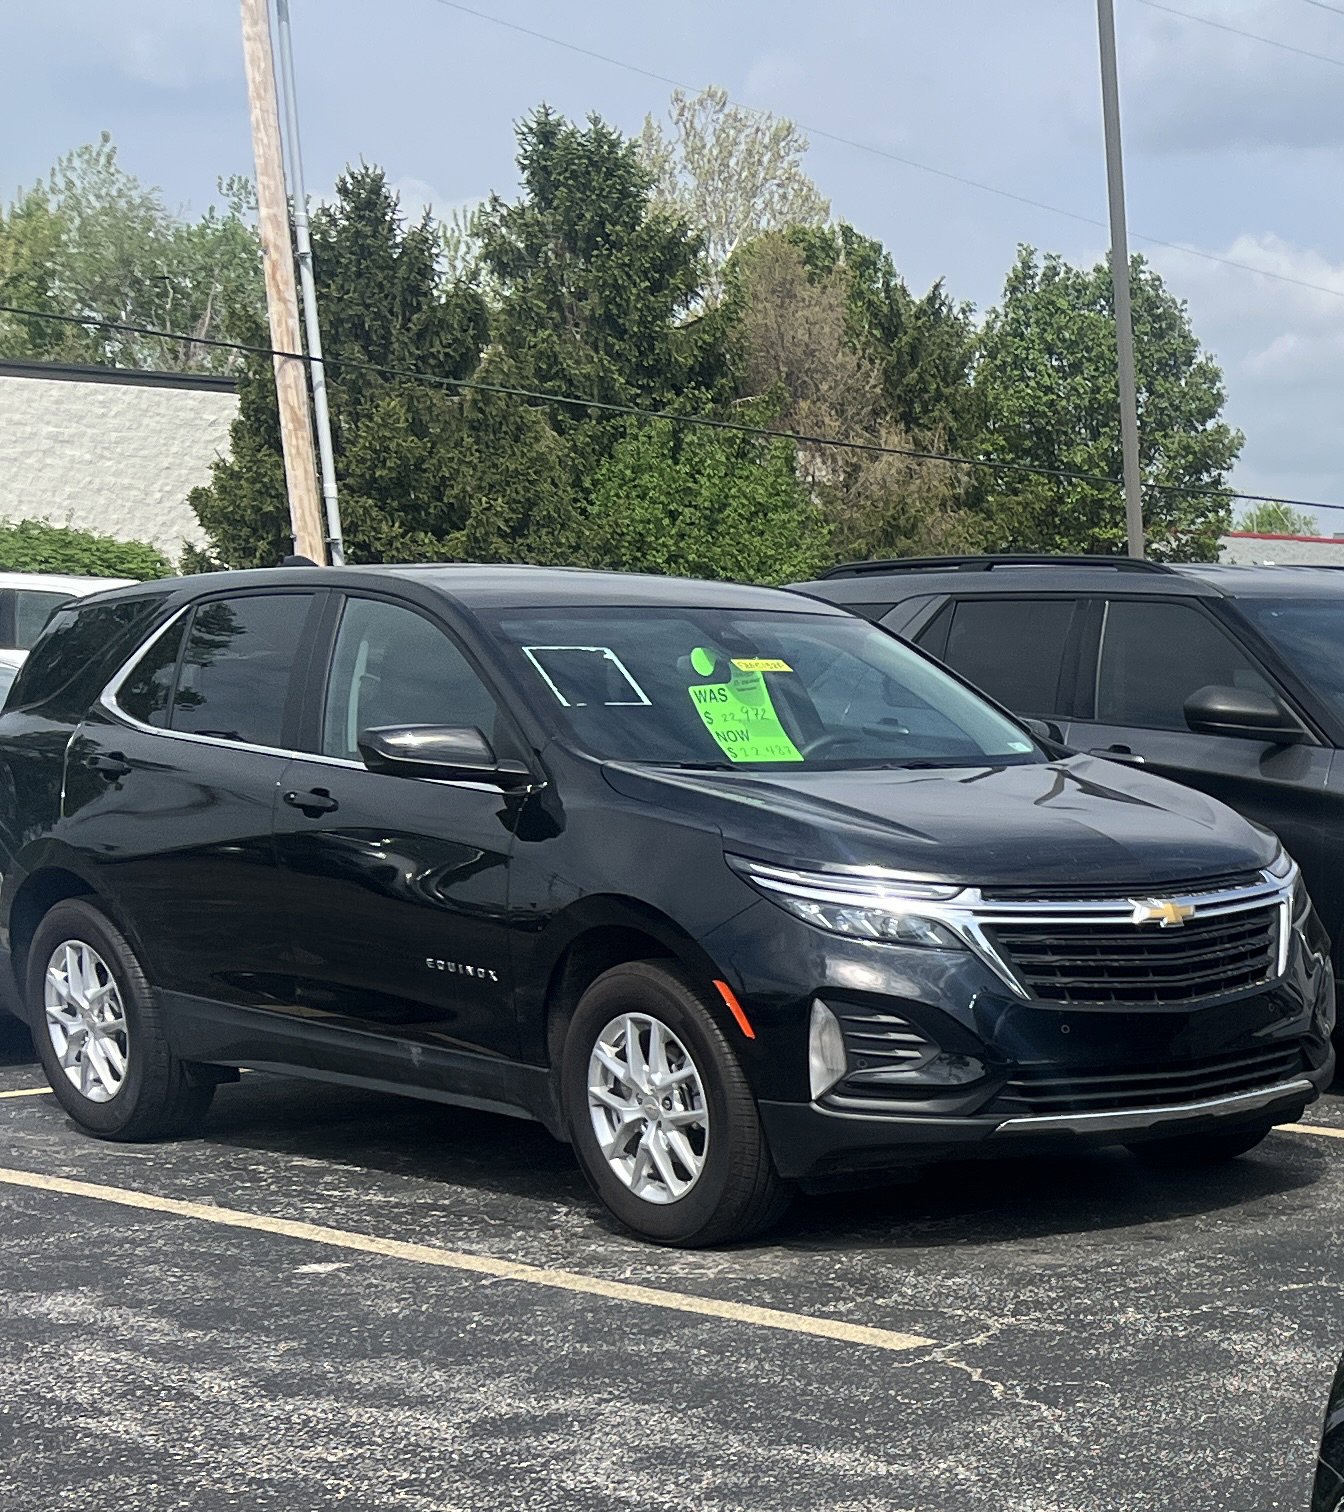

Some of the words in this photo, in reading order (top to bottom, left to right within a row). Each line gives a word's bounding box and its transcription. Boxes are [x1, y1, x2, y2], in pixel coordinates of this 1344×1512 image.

[693, 687, 729, 703] WAS
[715, 729, 750, 743] NOW
[425, 958, 498, 982] EQUINOX
